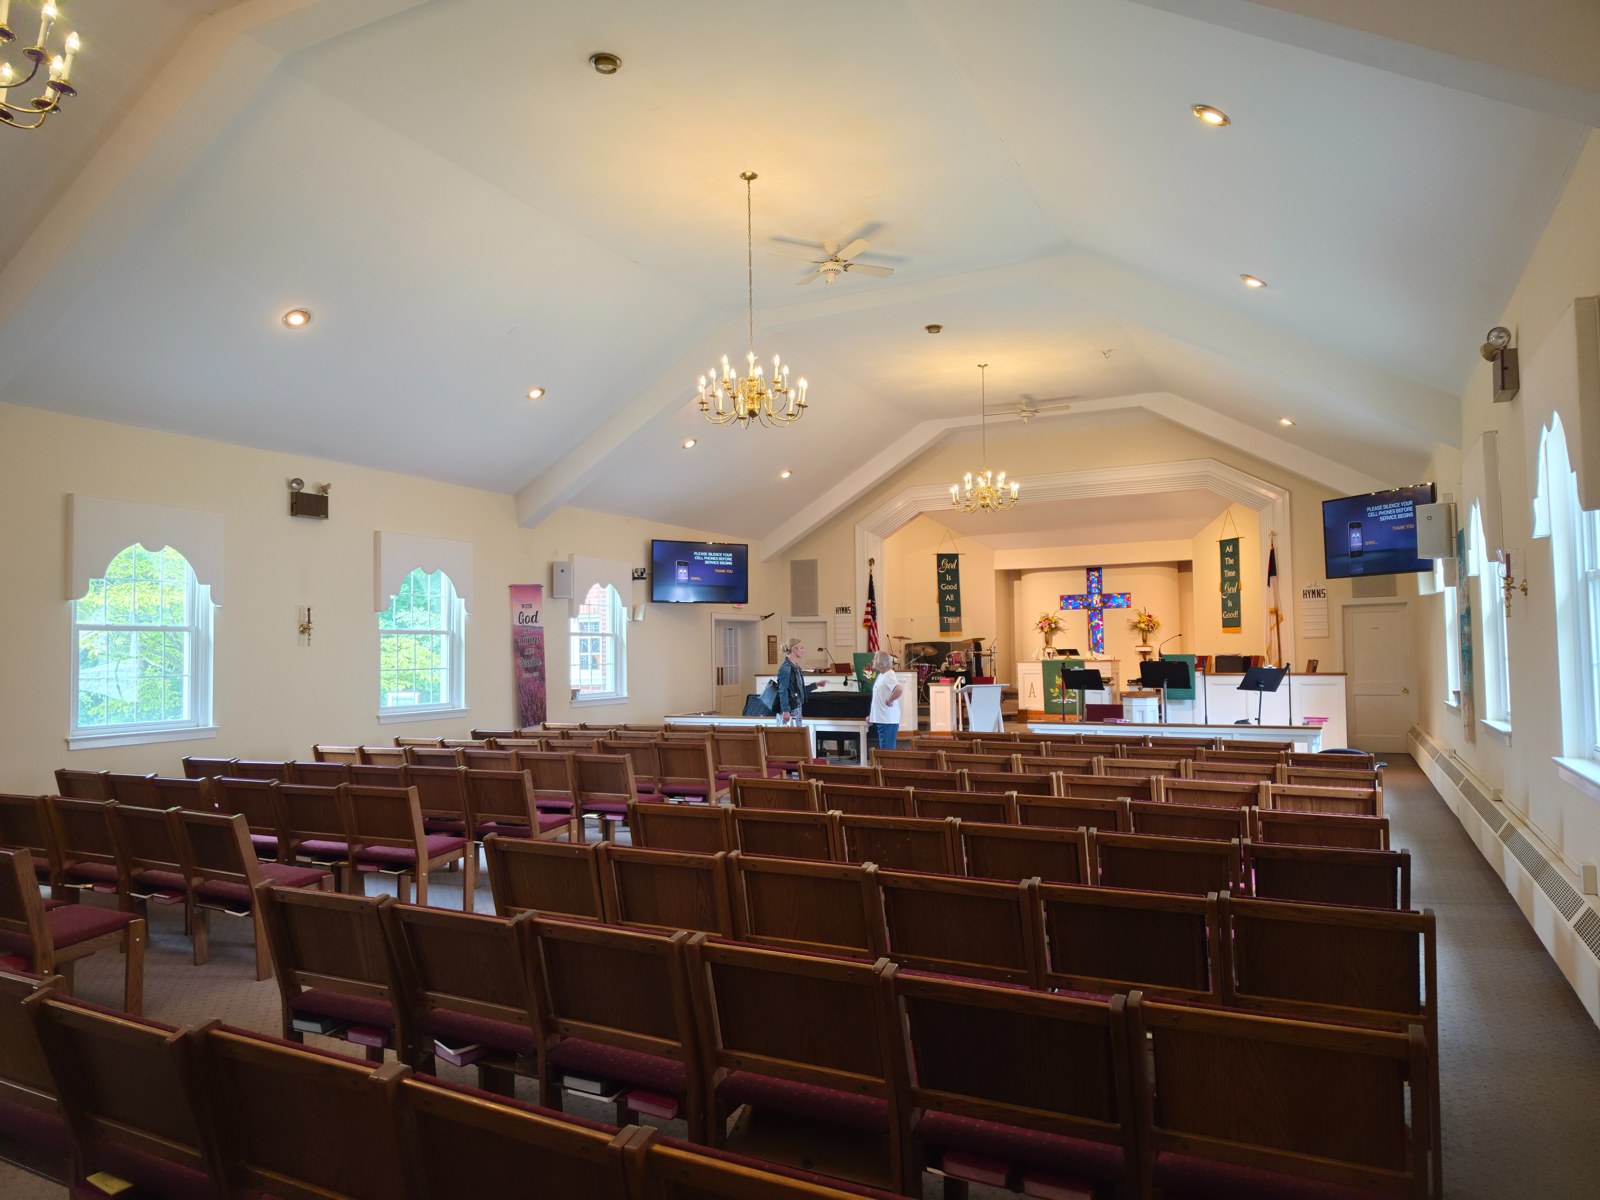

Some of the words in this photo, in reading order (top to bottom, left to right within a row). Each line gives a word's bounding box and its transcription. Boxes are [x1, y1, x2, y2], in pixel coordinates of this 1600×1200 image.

[938, 559, 957, 573] God
[1222, 582, 1237, 599] God
[1302, 588, 1326, 599] HYMNS
[518, 610, 539, 624] God
[836, 606, 852, 614] HYMNS
